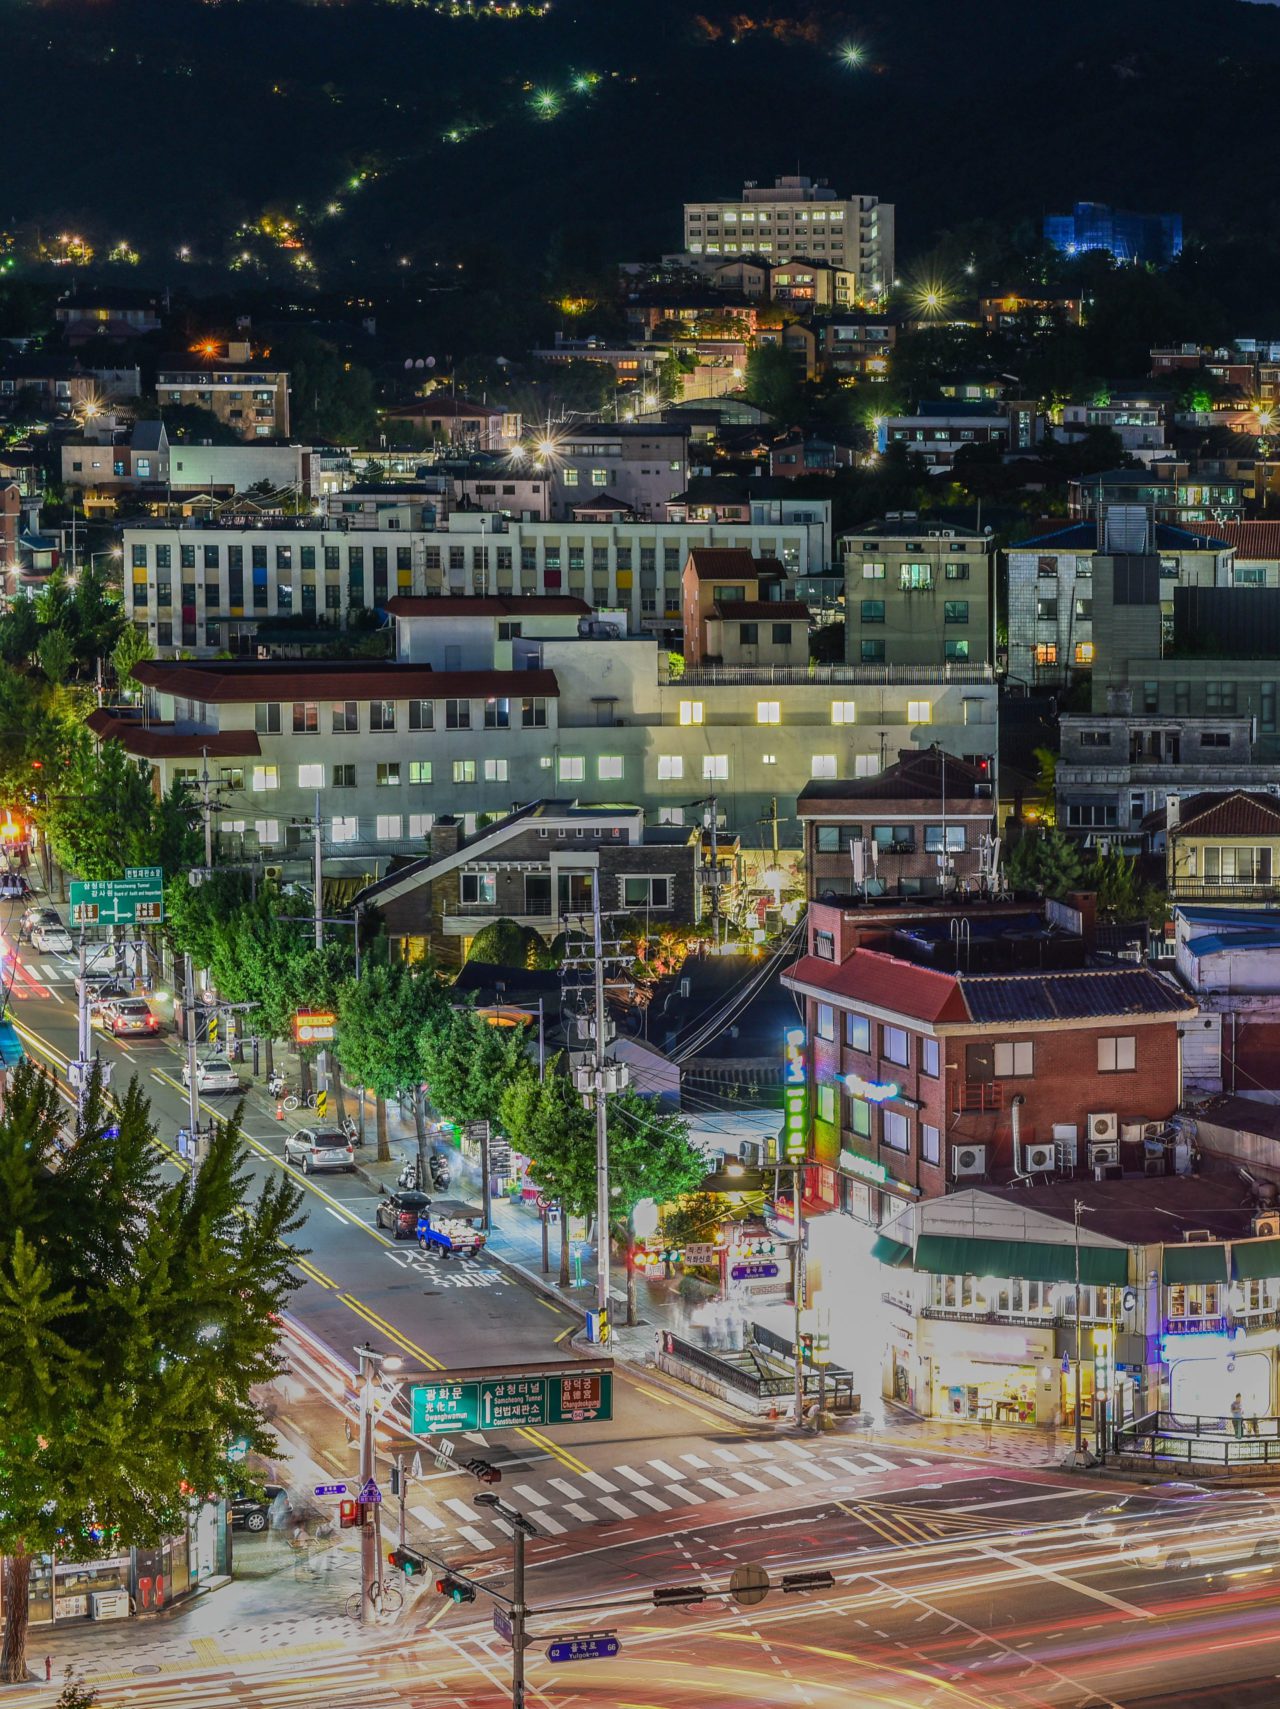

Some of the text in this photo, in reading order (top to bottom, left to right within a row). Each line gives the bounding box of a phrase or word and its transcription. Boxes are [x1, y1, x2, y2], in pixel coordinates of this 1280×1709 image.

[494, 1382, 540, 1396] 삼청터널
[563, 1378, 592, 1391] 창덕궁
[425, 1387, 463, 1401] 광화문
[525, 1394, 543, 1402] Tunnel
[425, 1400, 457, 1413] 光化門
[494, 1404, 540, 1417] 헌법재판소
[493, 1416, 542, 1426] Constitutional Court
[551, 1641, 616, 1657] 62 율곡로 66
[569, 1651, 599, 1659] Yulgok-ro
